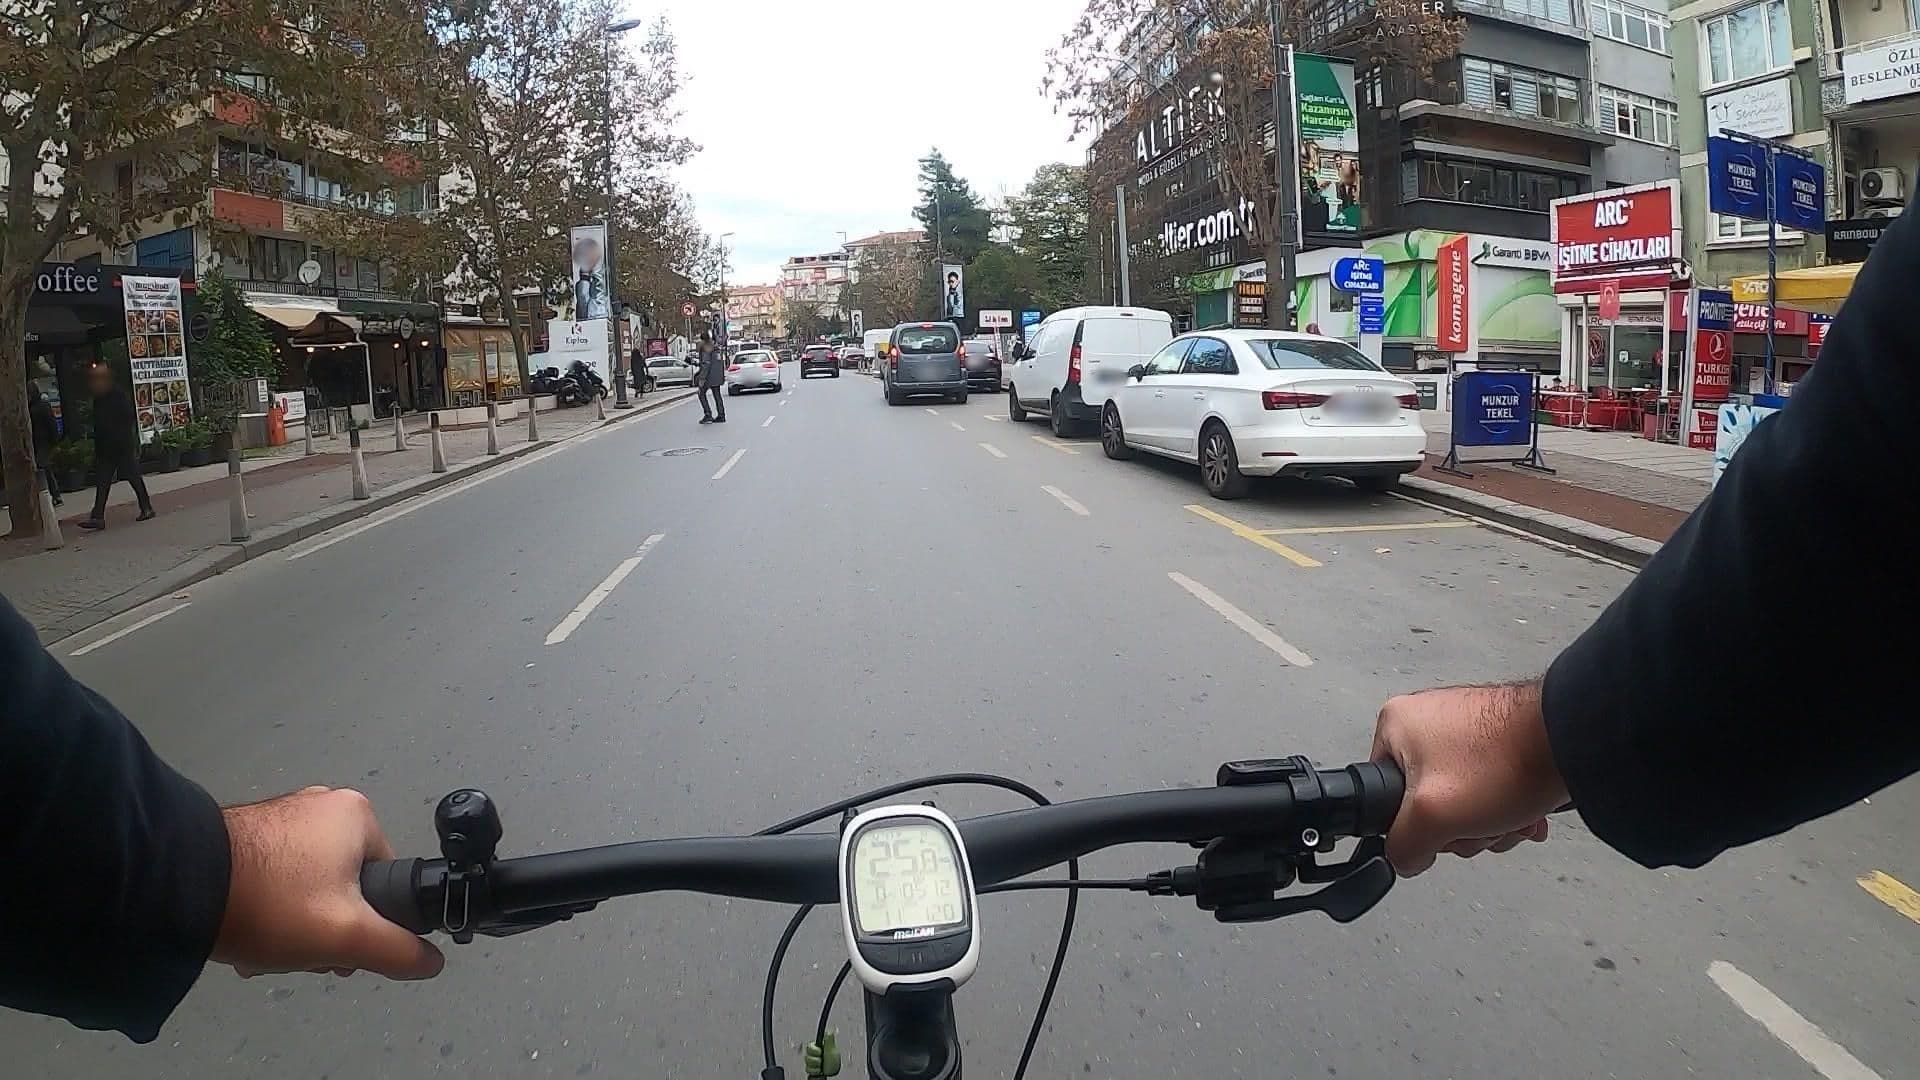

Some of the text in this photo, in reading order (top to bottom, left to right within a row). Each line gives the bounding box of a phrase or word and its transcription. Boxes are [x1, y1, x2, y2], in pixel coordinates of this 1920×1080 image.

[1732, 176, 1754, 191] TEKEL
[1796, 191, 1814, 206] TEKEL
[1833, 229, 1878, 240] RAINBOW
[1492, 246, 1551, 261] Garanti BBVA
[1559, 237, 1671, 270] İŞİTME CİHAZLARI
[1449, 249, 1465, 343] komagene
[1481, 395, 1520, 406] MUNZUR
[1486, 408, 1514, 419] TEKEL
